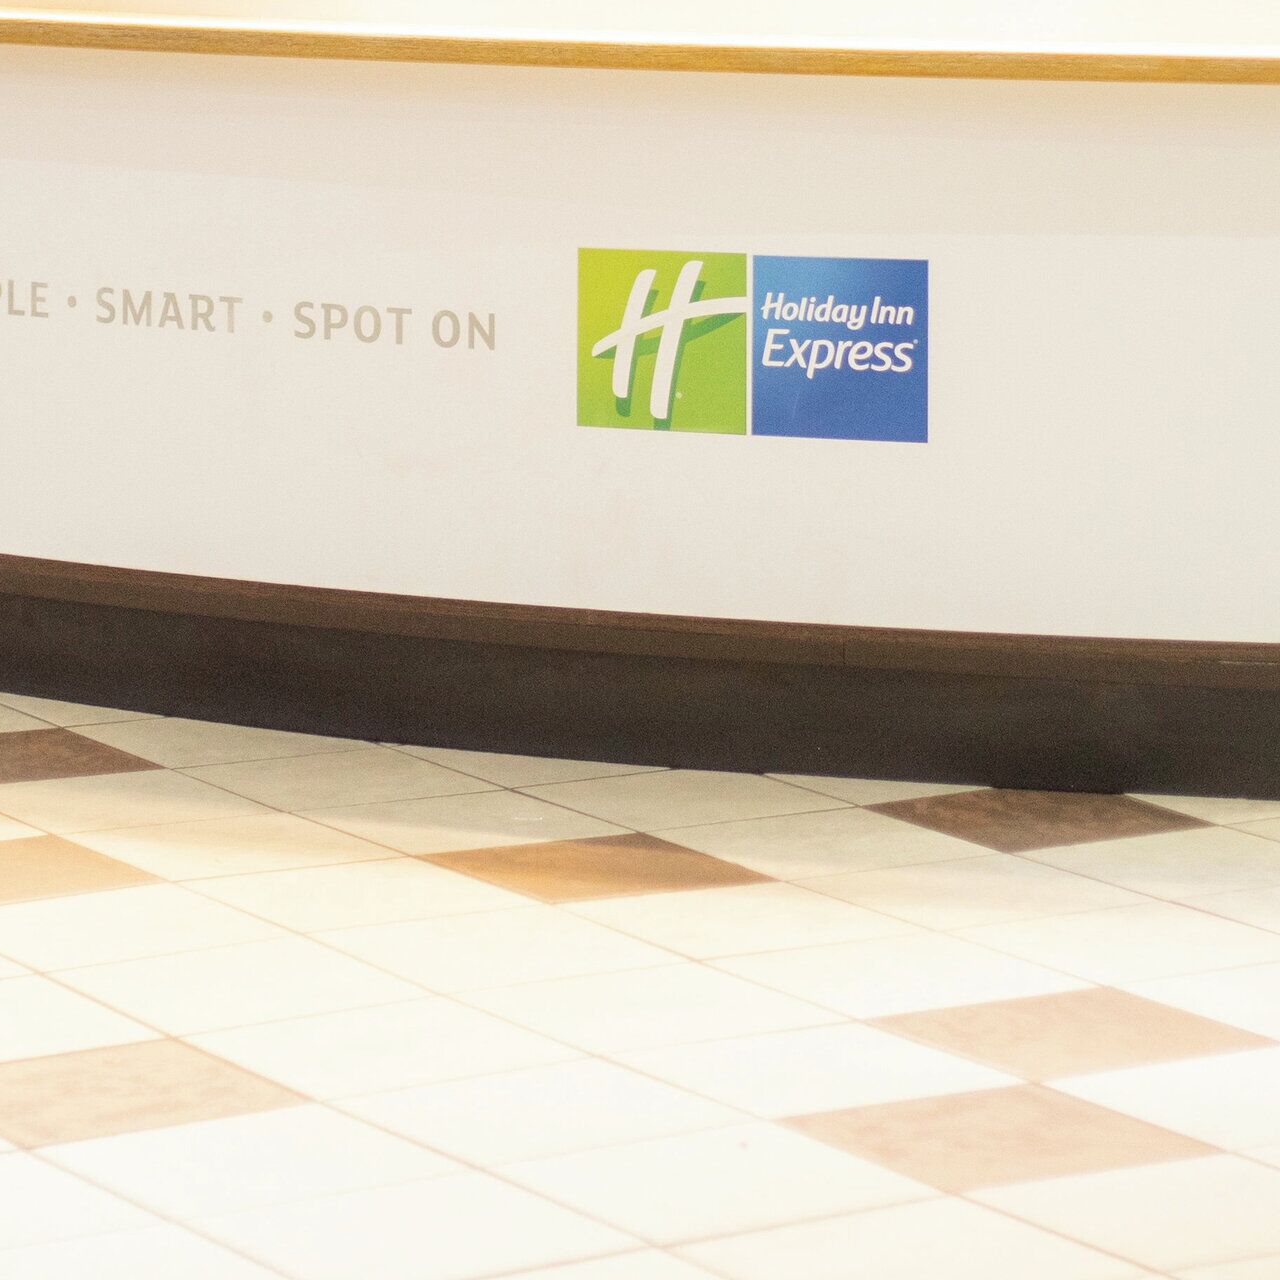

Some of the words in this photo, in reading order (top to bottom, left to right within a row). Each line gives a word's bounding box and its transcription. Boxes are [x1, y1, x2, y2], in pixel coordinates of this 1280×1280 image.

[95, 286, 244, 334] SMART
[293, 301, 413, 345] SPOT
[431, 309, 496, 351] ON
[761, 292, 868, 330] Holiday
[870, 296, 915, 325] Inn
[761, 328, 916, 379] Express
